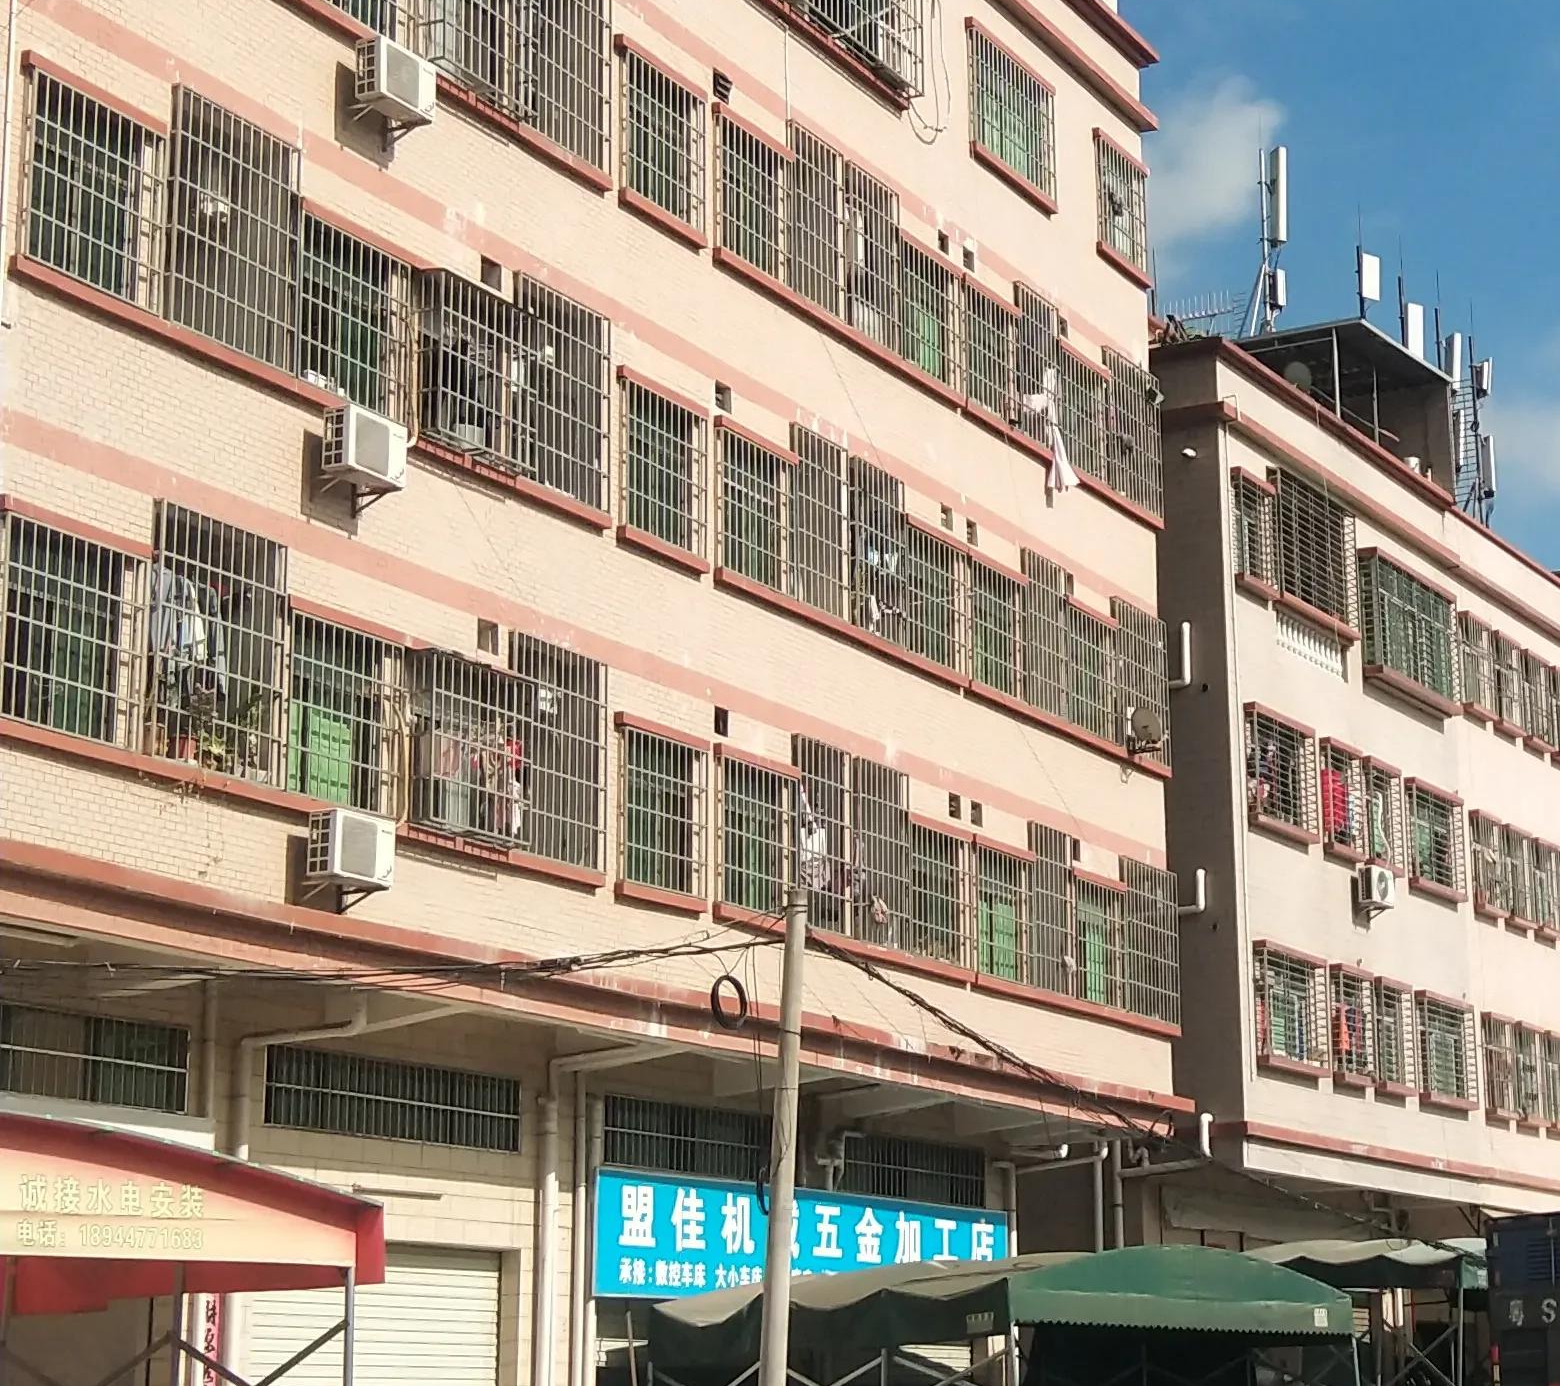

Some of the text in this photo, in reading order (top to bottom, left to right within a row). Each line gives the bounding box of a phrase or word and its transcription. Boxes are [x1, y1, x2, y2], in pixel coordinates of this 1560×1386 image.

[19, 1174, 204, 1219] 诚接水电安装
